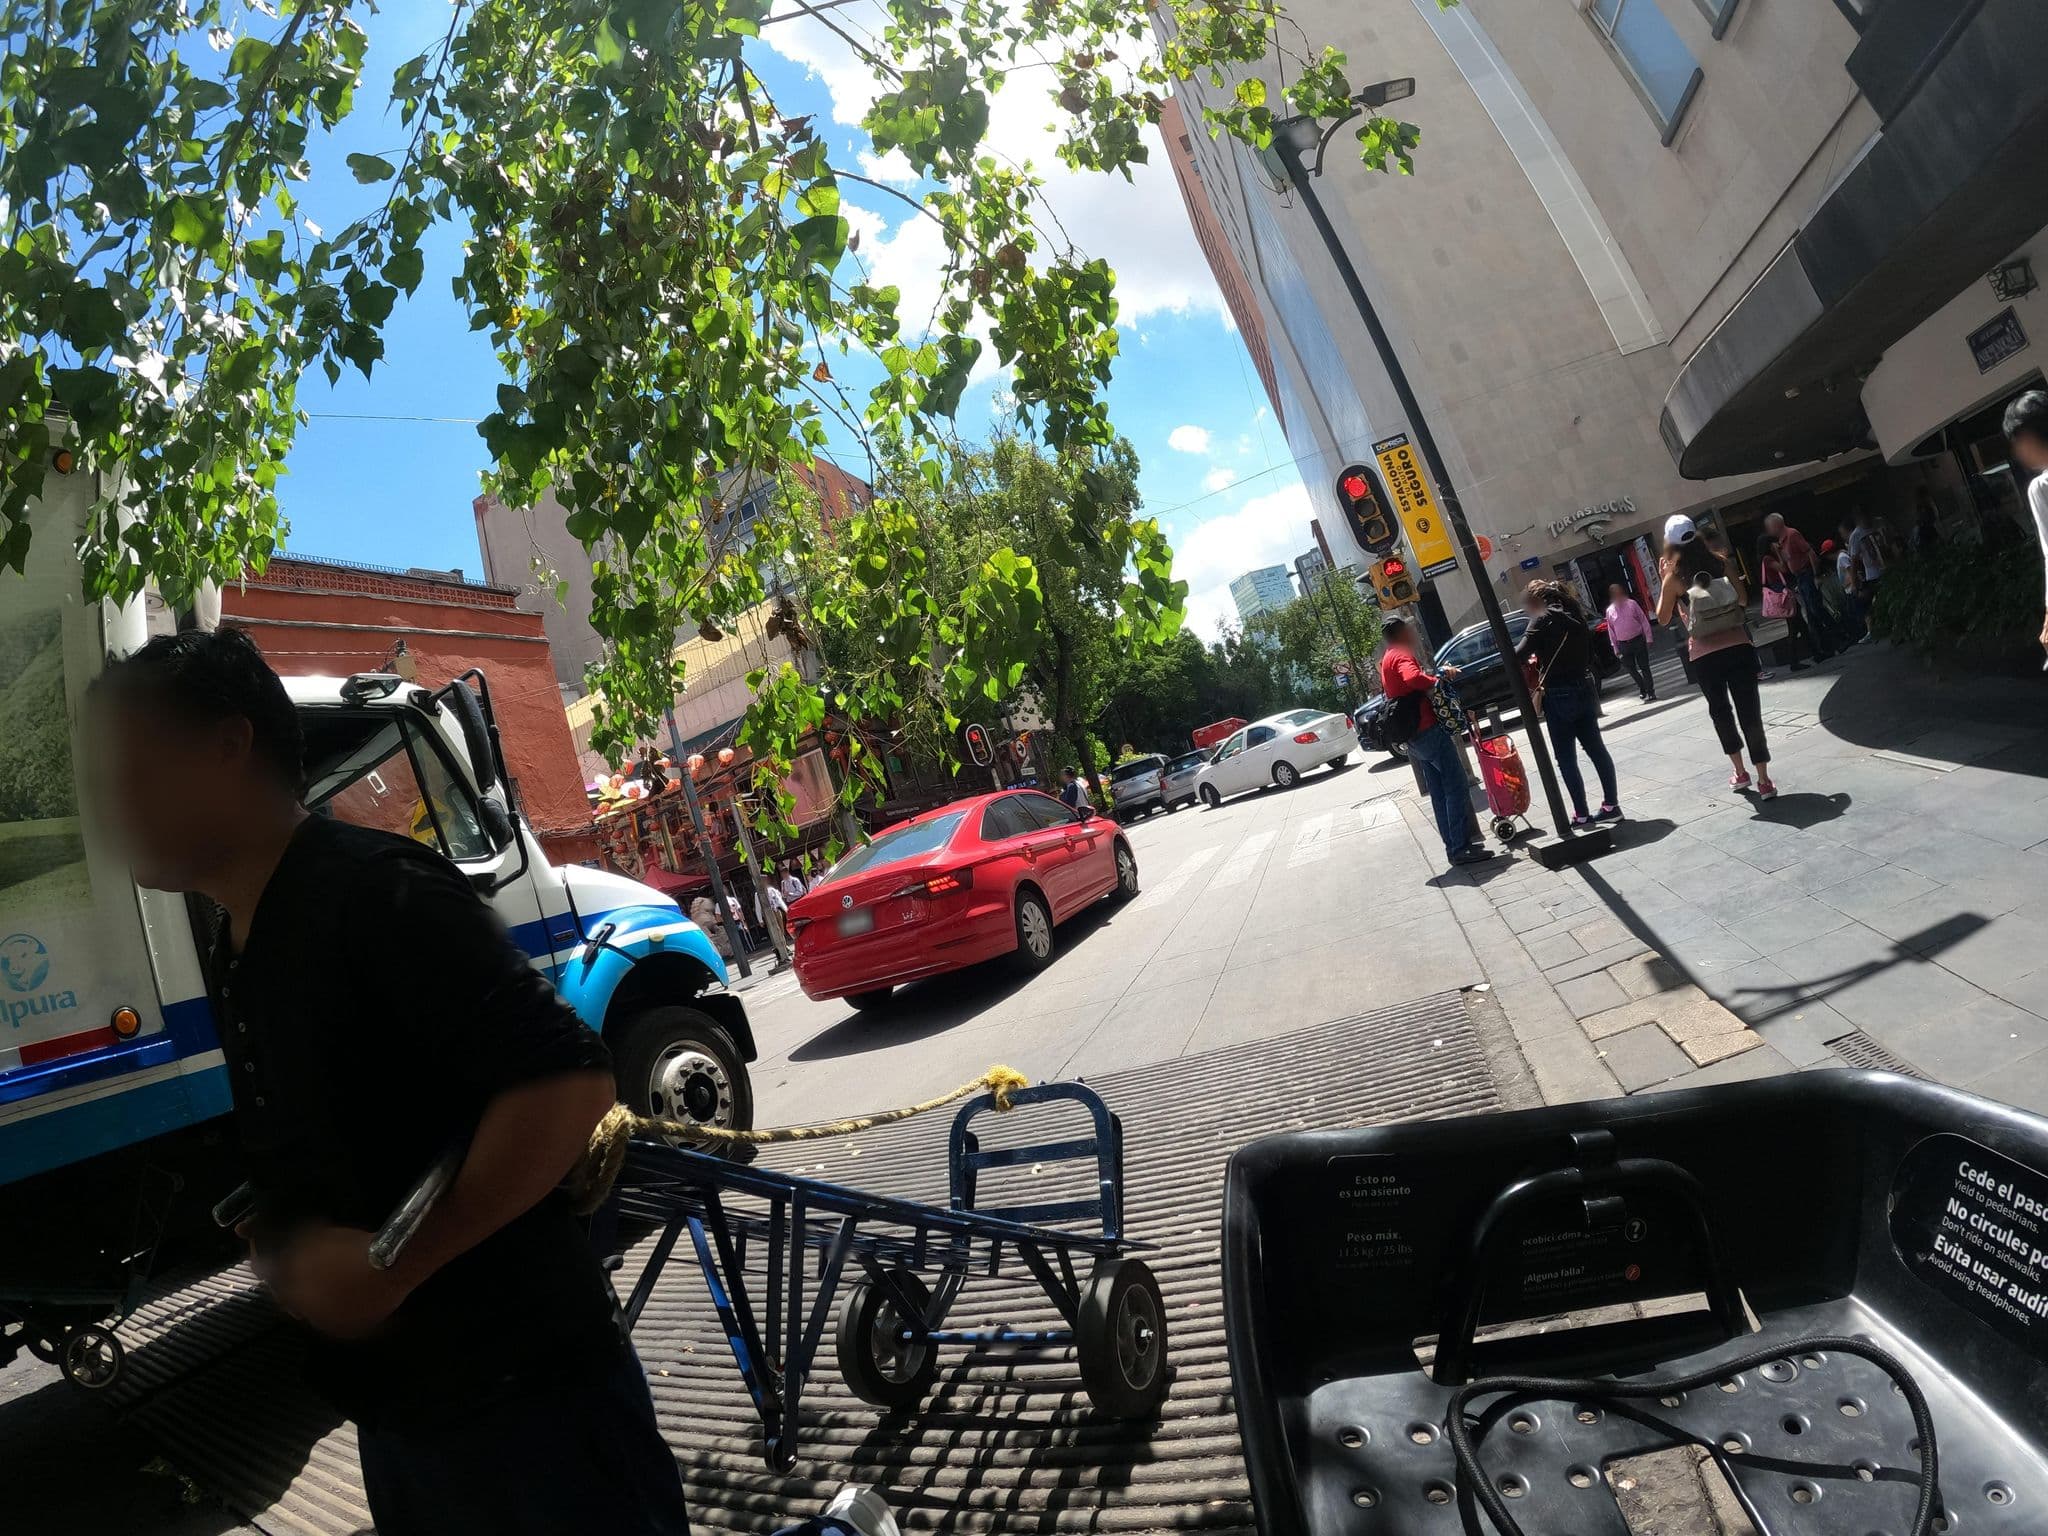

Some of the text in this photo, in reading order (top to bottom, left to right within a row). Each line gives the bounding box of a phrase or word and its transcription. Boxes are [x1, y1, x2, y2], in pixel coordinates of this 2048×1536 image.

[1383, 454, 1411, 512] ESTACIONA
[1396, 465, 1412, 497] TU AUTO
[1398, 450, 1428, 507] SEGURO
[0, 990, 77, 1028] lpura
[1339, 1185, 1411, 1199] es un asiento
[1355, 1175, 1396, 1185] Esto no
[1954, 1179, 2039, 1234] Yield to pedestrians.
[1959, 1161, 1995, 1191] Cede
[1998, 1183, 2014, 1201] el
[1346, 1232, 1373, 1242] Peso
[1941, 1215, 2041, 1283] Don't ride on sidewalks.
[1947, 1197, 1968, 1220] No
[1969, 1213, 2029, 1256] circules
[1934, 1233, 1971, 1268] Evita
[1972, 1260, 2008, 1289] usar
[1927, 1252, 2031, 1326] Avoid using headphones.
